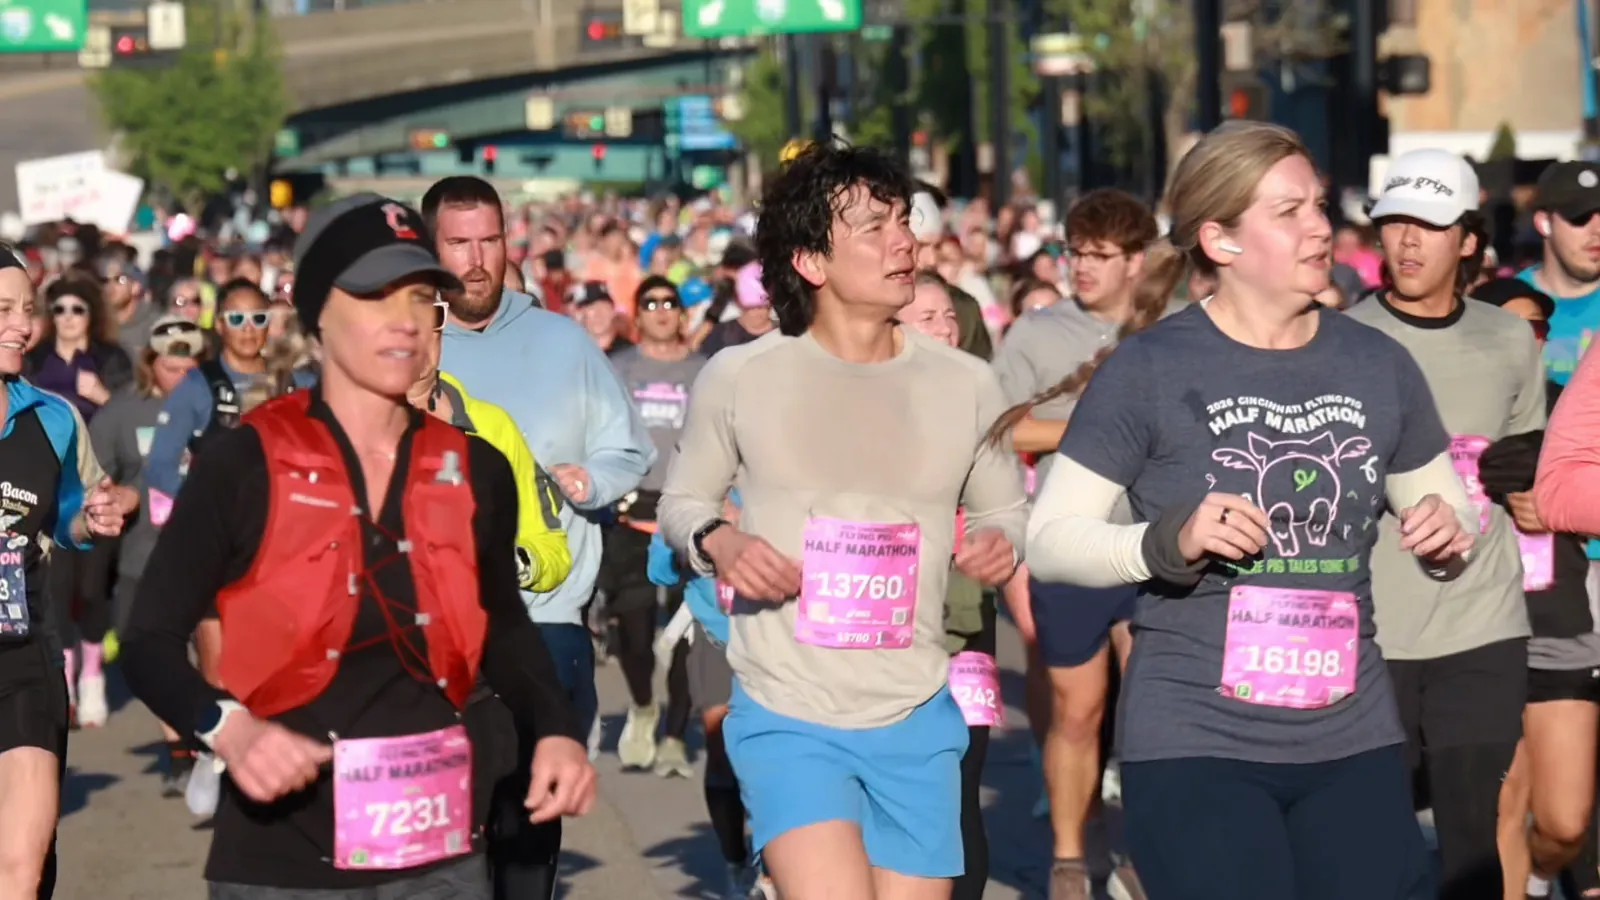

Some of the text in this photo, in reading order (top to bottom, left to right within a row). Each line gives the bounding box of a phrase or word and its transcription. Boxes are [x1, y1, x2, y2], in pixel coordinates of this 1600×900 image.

[1206, 394, 1363, 414] 2026 CINCINNATI FLYING PIG
[1208, 406, 1366, 436] HALF MARATHON
[0, 481, 38, 505] Bacon
[805, 540, 917, 558] HALF MARATHON
[816, 571, 903, 600] 13760
[1232, 610, 1355, 630] HALF MARATHON
[1244, 645, 1340, 677] 16198
[366, 793, 450, 837] 7231
